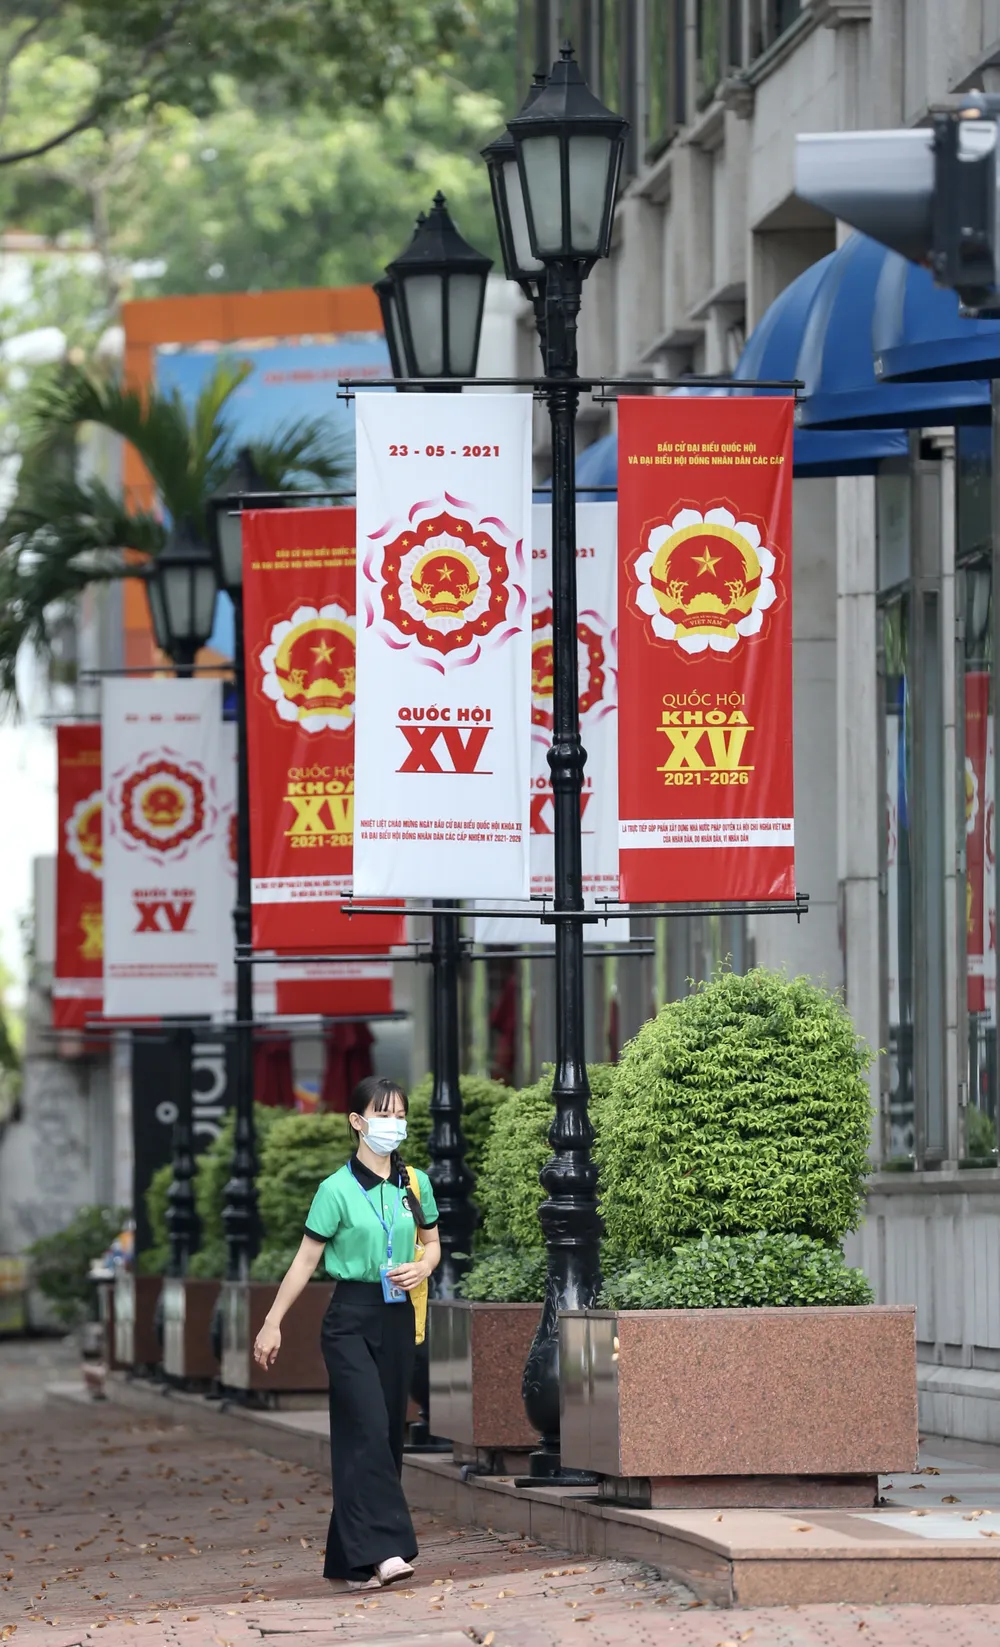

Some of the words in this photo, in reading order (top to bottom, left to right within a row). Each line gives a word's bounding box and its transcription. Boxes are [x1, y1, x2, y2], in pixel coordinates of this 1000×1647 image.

[389, 445, 408, 457] 23
[425, 445, 445, 457] 05
[462, 445, 500, 457] 2021
[662, 689, 711, 708] QUỐC
[716, 691, 745, 708] HỘI
[398, 703, 451, 721] QUỐC
[457, 705, 491, 725] HỘI
[662, 708, 749, 725] KHÓA
[395, 725, 493, 774] XV
[656, 726, 755, 771] XV
[664, 772, 749, 785] 2021-2026
[290, 835, 354, 848] 2021-202
[133, 901, 194, 932] XV
